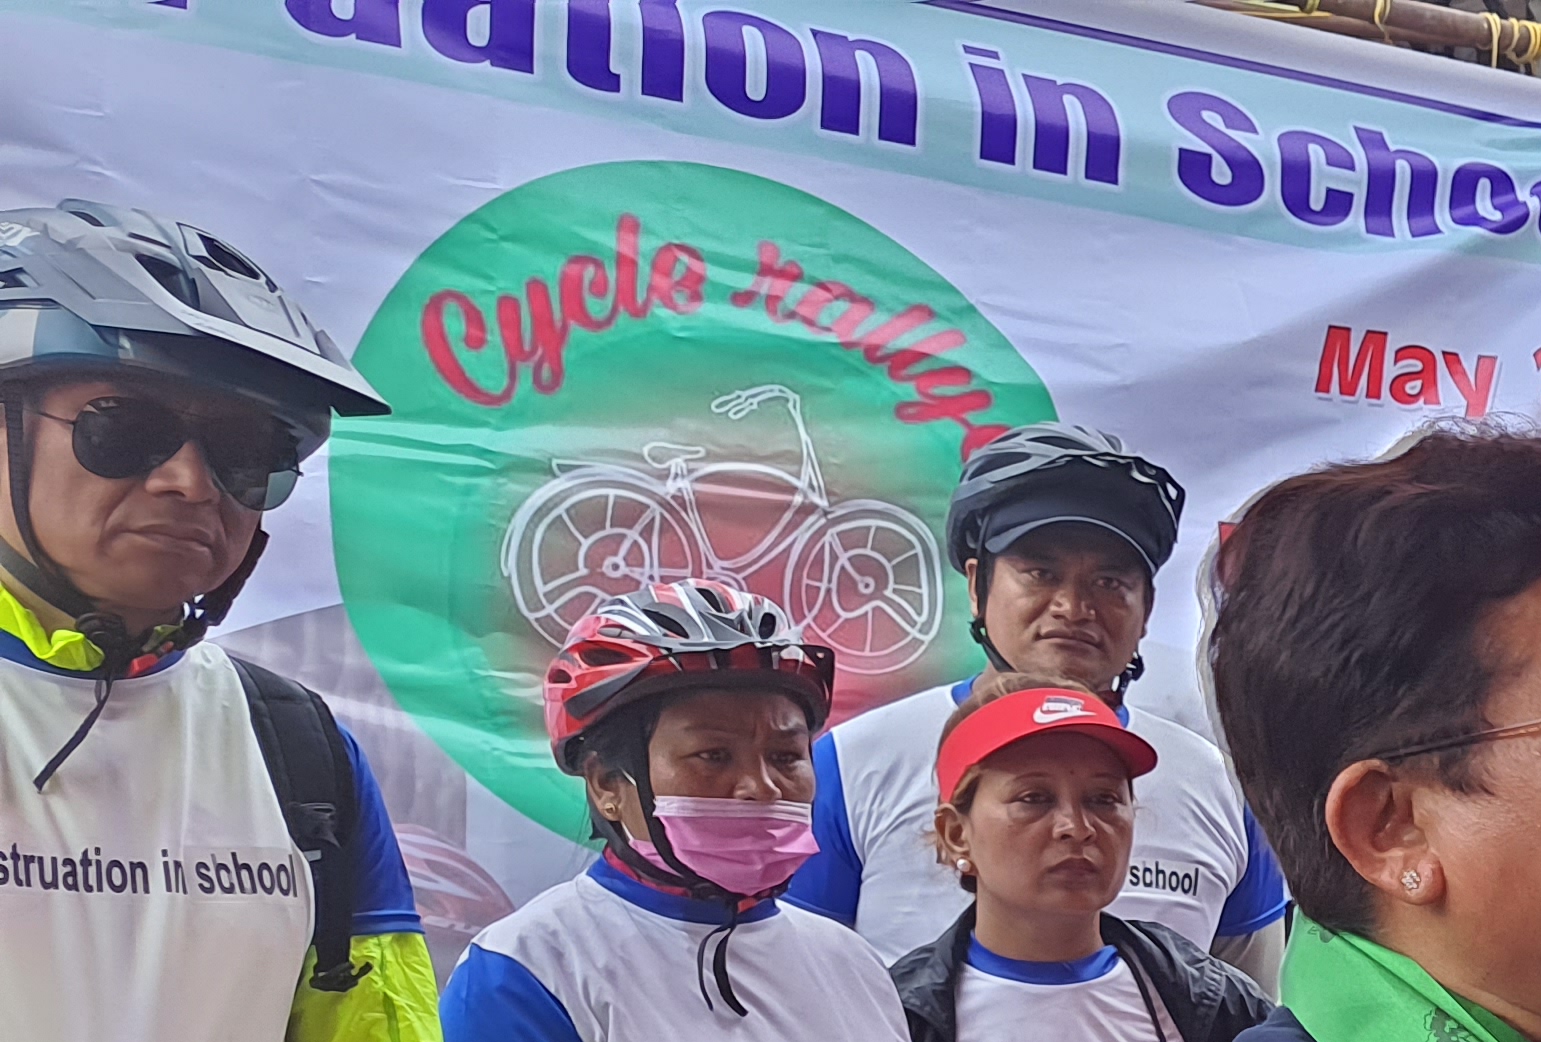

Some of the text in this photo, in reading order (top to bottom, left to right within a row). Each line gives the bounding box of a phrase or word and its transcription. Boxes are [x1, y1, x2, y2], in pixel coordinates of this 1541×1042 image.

[962, 44, 1122, 186] in
[421, 213, 706, 407] Cycle
[1315, 324, 1498, 419] May
[161, 849, 188, 895] in
[195, 852, 298, 898] school
[1129, 860, 1199, 897] school
